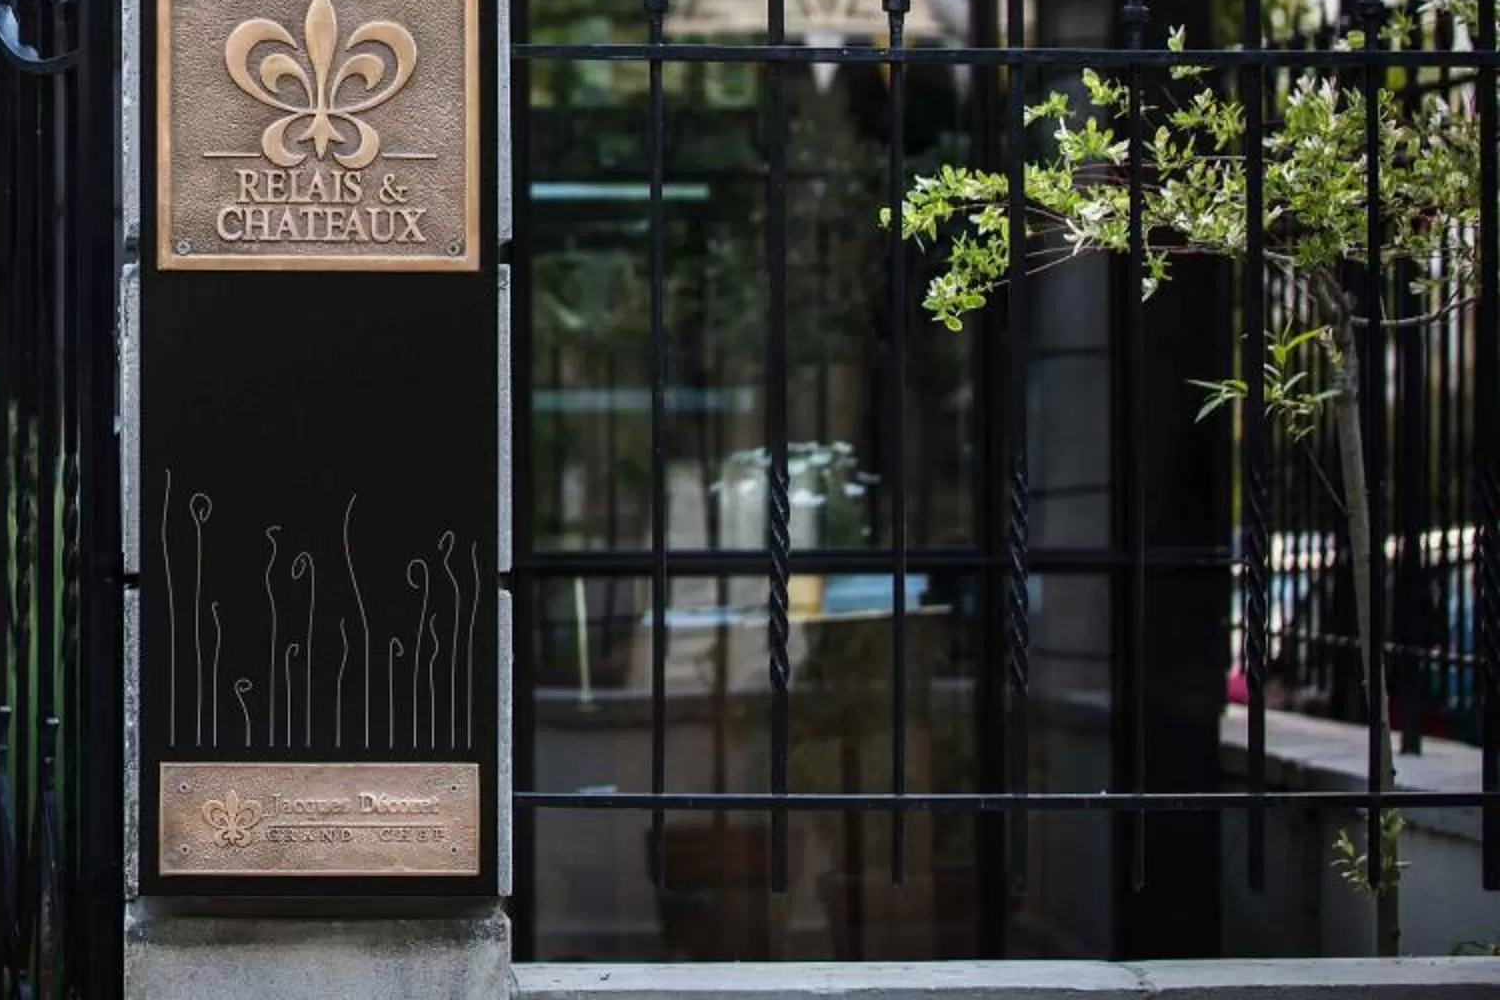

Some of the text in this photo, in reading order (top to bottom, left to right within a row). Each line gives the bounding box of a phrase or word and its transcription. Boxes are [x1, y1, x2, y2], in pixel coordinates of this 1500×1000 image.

[235, 169, 410, 205] RELAIS &
[216, 207, 428, 243] CHATEAUX
[266, 827, 354, 843] GRAND
